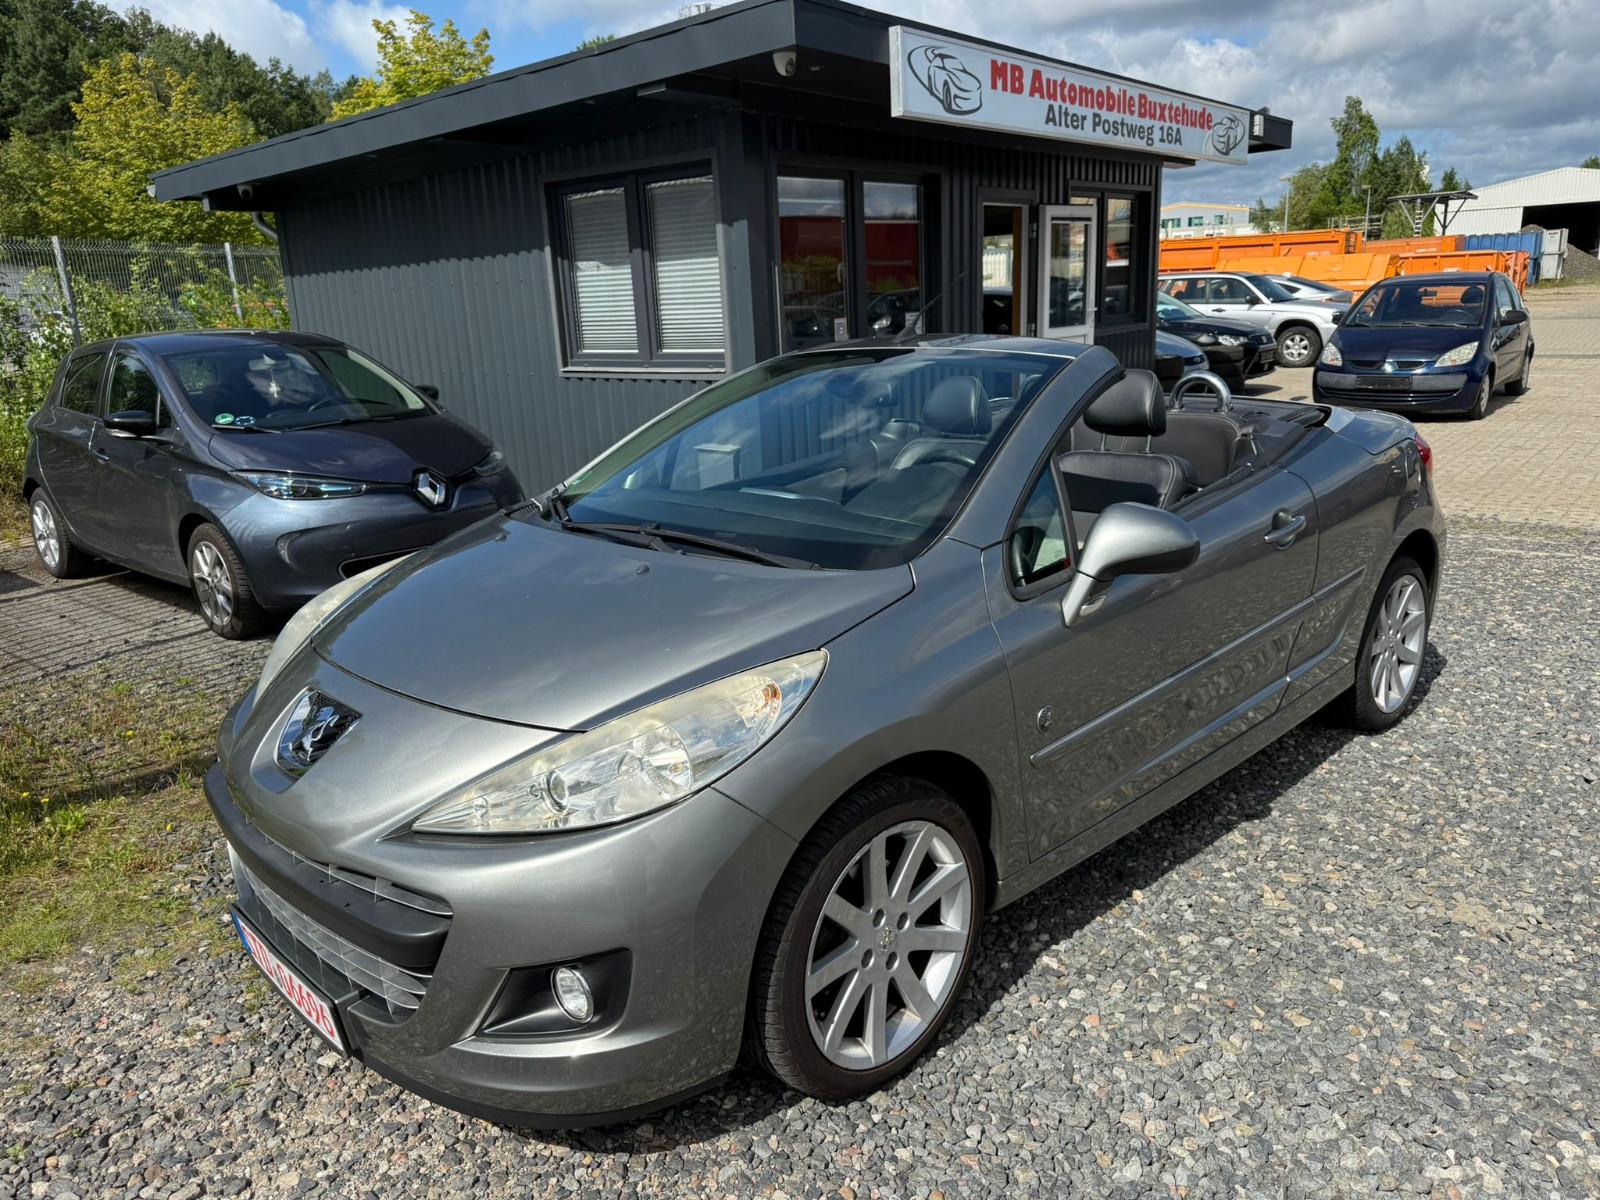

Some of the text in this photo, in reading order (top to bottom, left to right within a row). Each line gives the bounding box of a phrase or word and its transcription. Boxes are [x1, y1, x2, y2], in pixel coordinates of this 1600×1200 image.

[991, 60, 1213, 131] MB Automobile Buxtehude
[1045, 104, 1183, 147] Alter Postweg 16A
